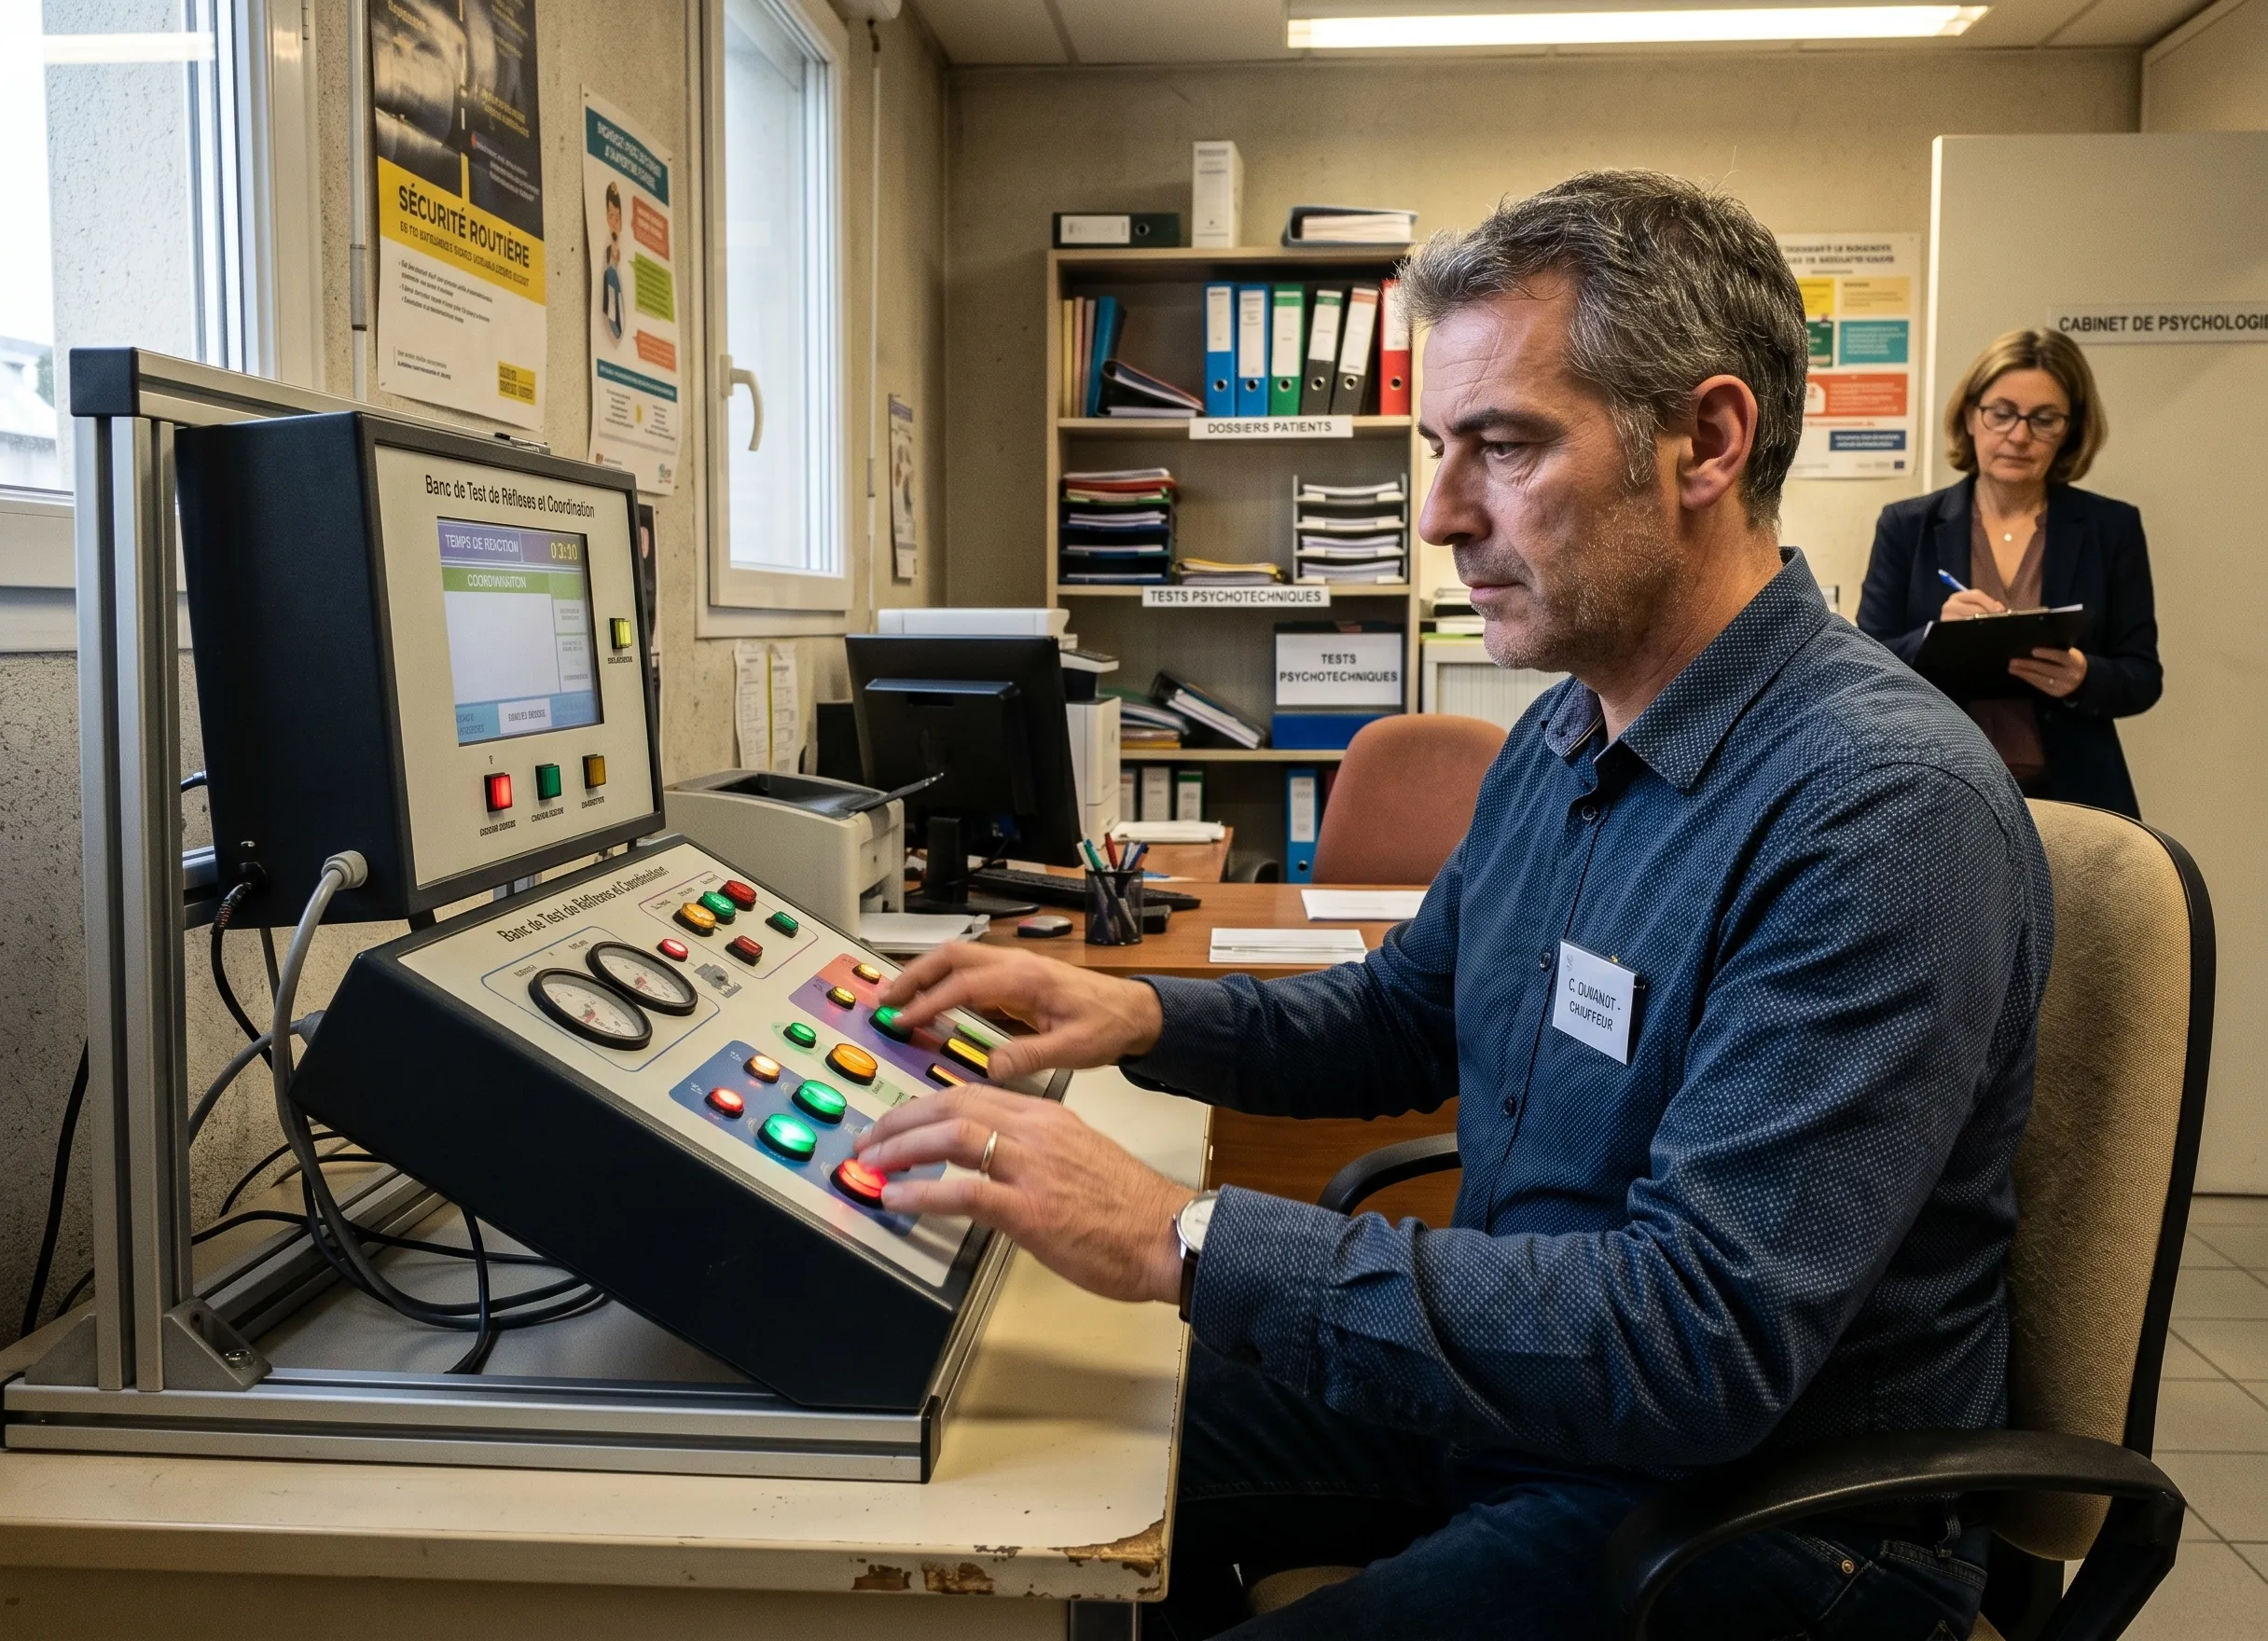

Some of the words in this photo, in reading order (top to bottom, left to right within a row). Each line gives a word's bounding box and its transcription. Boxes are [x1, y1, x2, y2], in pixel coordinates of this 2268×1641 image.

[398, 183, 466, 240] SÉCURITÉ
[470, 219, 530, 269] ROUTIÈRE
[2059, 316, 2129, 332] CABINET
[2133, 316, 2154, 332] DE
[1208, 422, 1269, 434] DOSSIERS
[1273, 421, 1332, 433] PATIENTS
[425, 475, 451, 497] Banc
[453, 479, 465, 499] de
[466, 481, 487, 503] Test
[489, 485, 500, 504] de
[547, 495, 595, 518] Coordination
[1151, 590, 1189, 602] TESTS
[1192, 590, 1321, 603] PSYCHOTECHNIQUES
[1321, 654, 1357, 665] TESTS
[1279, 671, 1399, 683] PSYCHOTECHNIQUES
[496, 925, 532, 943] Banc
[526, 918, 546, 931] de
